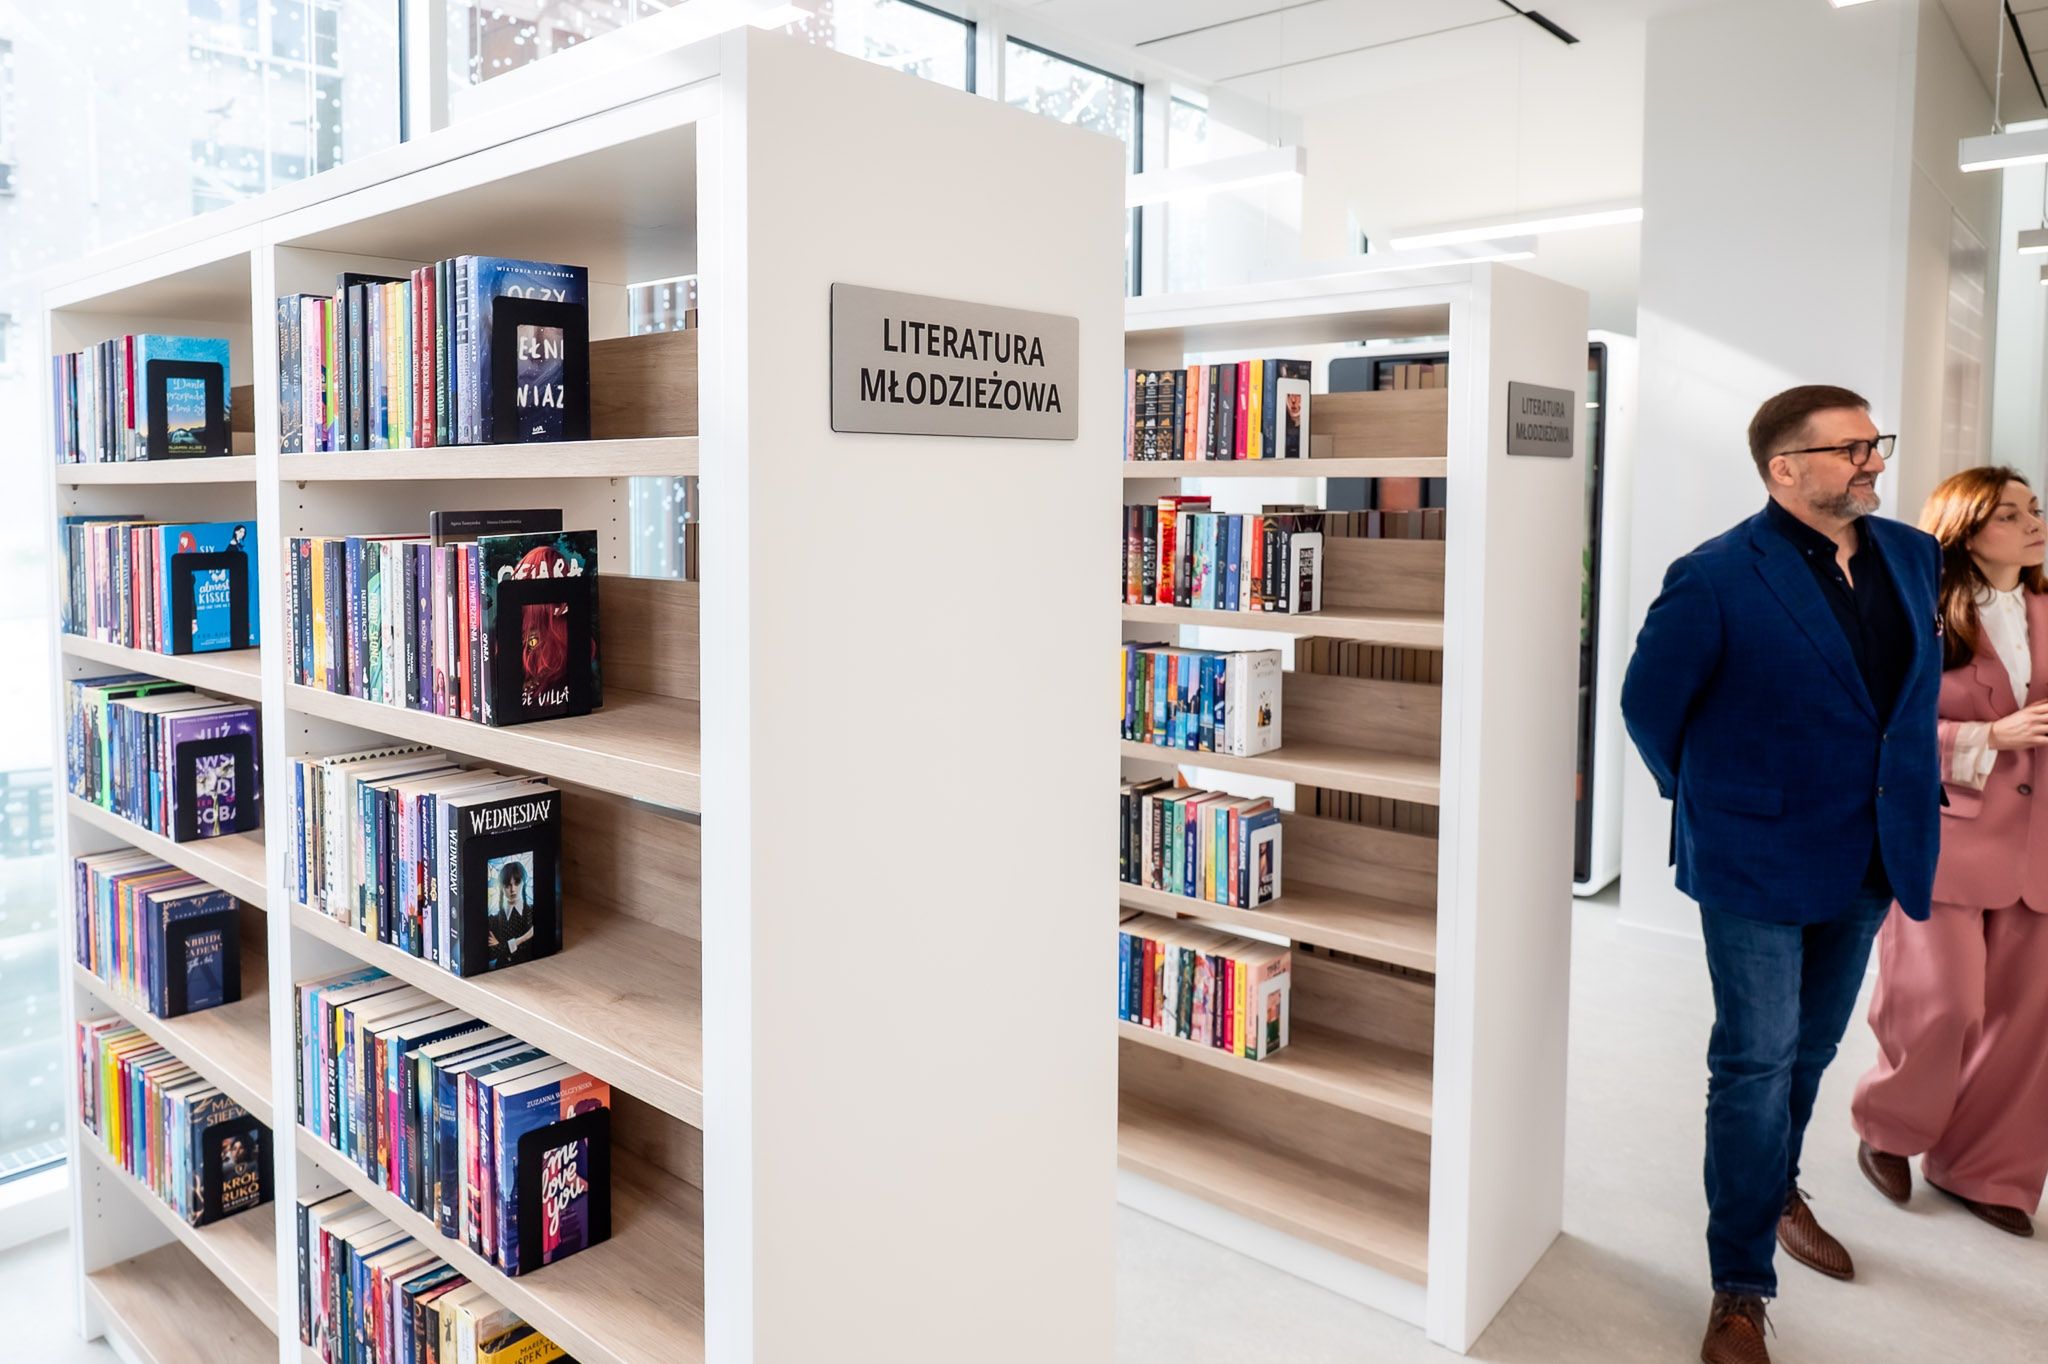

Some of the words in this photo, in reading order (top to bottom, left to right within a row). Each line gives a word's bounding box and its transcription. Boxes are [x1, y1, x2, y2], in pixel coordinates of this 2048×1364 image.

[496, 266, 532, 274] WIKTORIA
[534, 270, 574, 278] SZYMAŃSKA
[517, 336, 564, 361] EŁN
[884, 318, 1045, 367] LITERATURA
[860, 367, 1062, 413] MŁODZIEŻOWA
[1522, 396, 1565, 418] LITERATURA
[1516, 421, 1570, 442] MŁODZIEŻOWA
[522, 694, 532, 706] SE
[538, 686, 570, 706] VILLA
[470, 800, 552, 835] WEDNESDAY
[449, 828, 458, 896] WEDNESDAY
[526, 1094, 555, 1108] ZUZANNA
[547, 1140, 578, 1172] me
[542, 1162, 578, 1204] love
[546, 1178, 585, 1236] you
